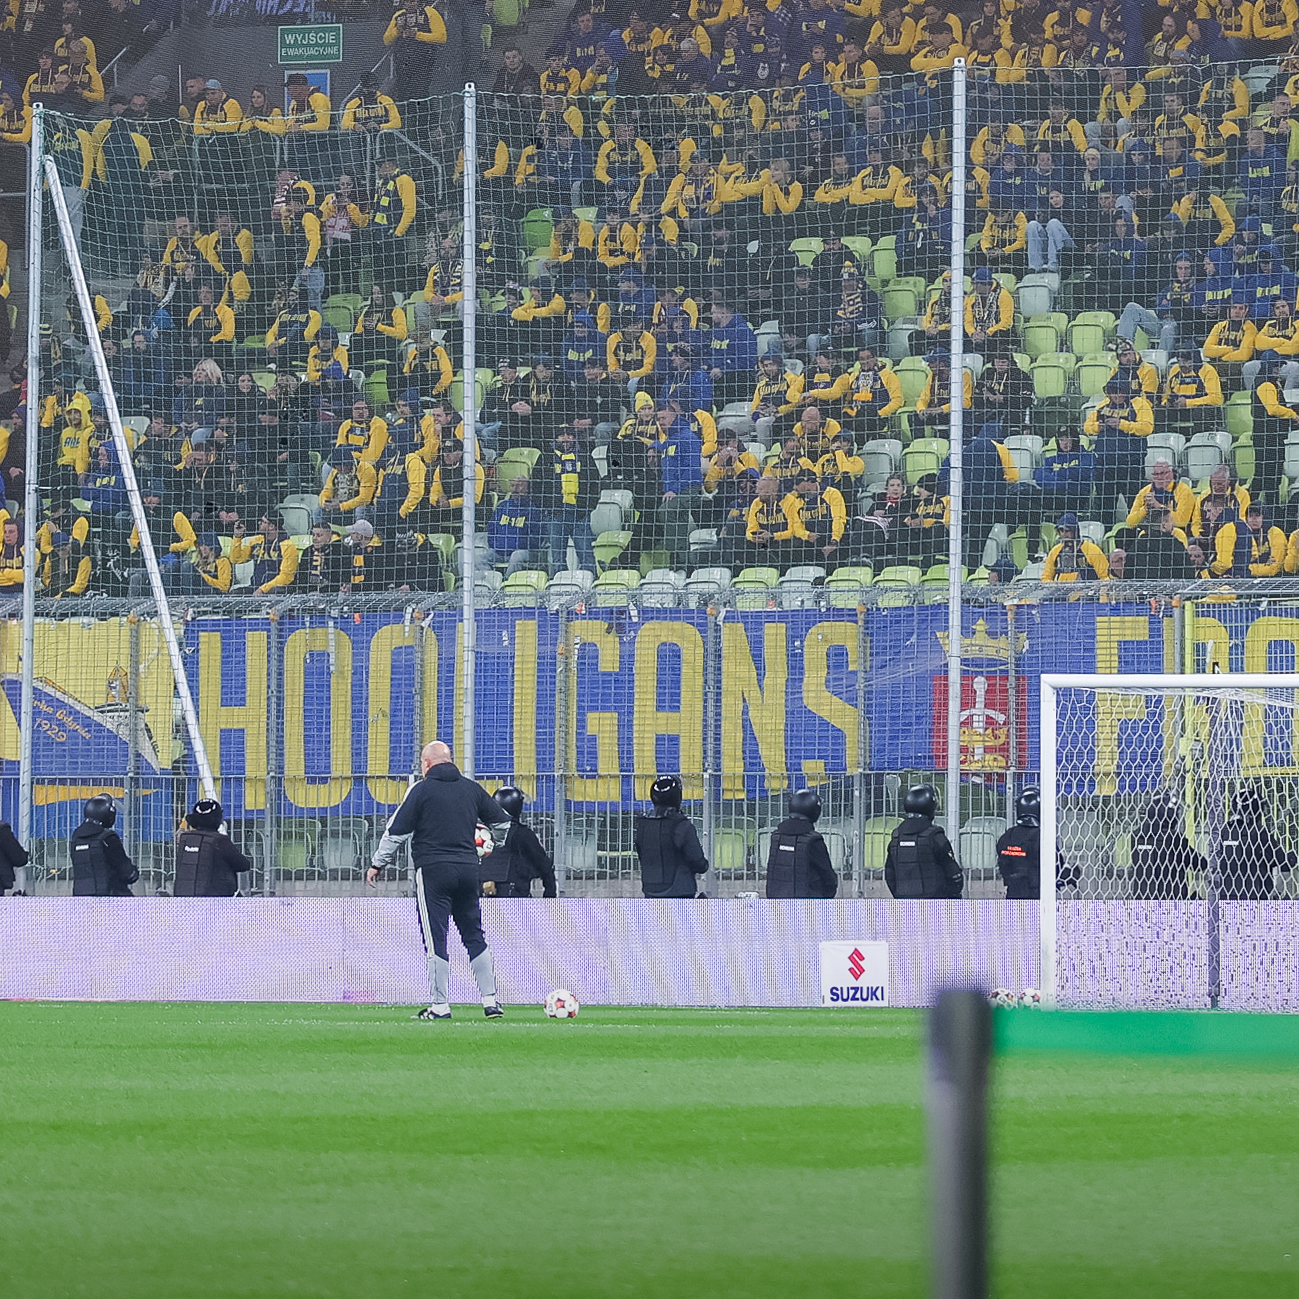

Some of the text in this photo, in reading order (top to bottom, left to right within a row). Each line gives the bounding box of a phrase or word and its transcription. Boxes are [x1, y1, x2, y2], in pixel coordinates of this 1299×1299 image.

[284, 32, 336, 45] WYJŚCIE
[281, 46, 339, 57] EWAKUACYJNE
[33, 717, 68, 743] 1929
[830, 986, 885, 1002] SUZUKI
